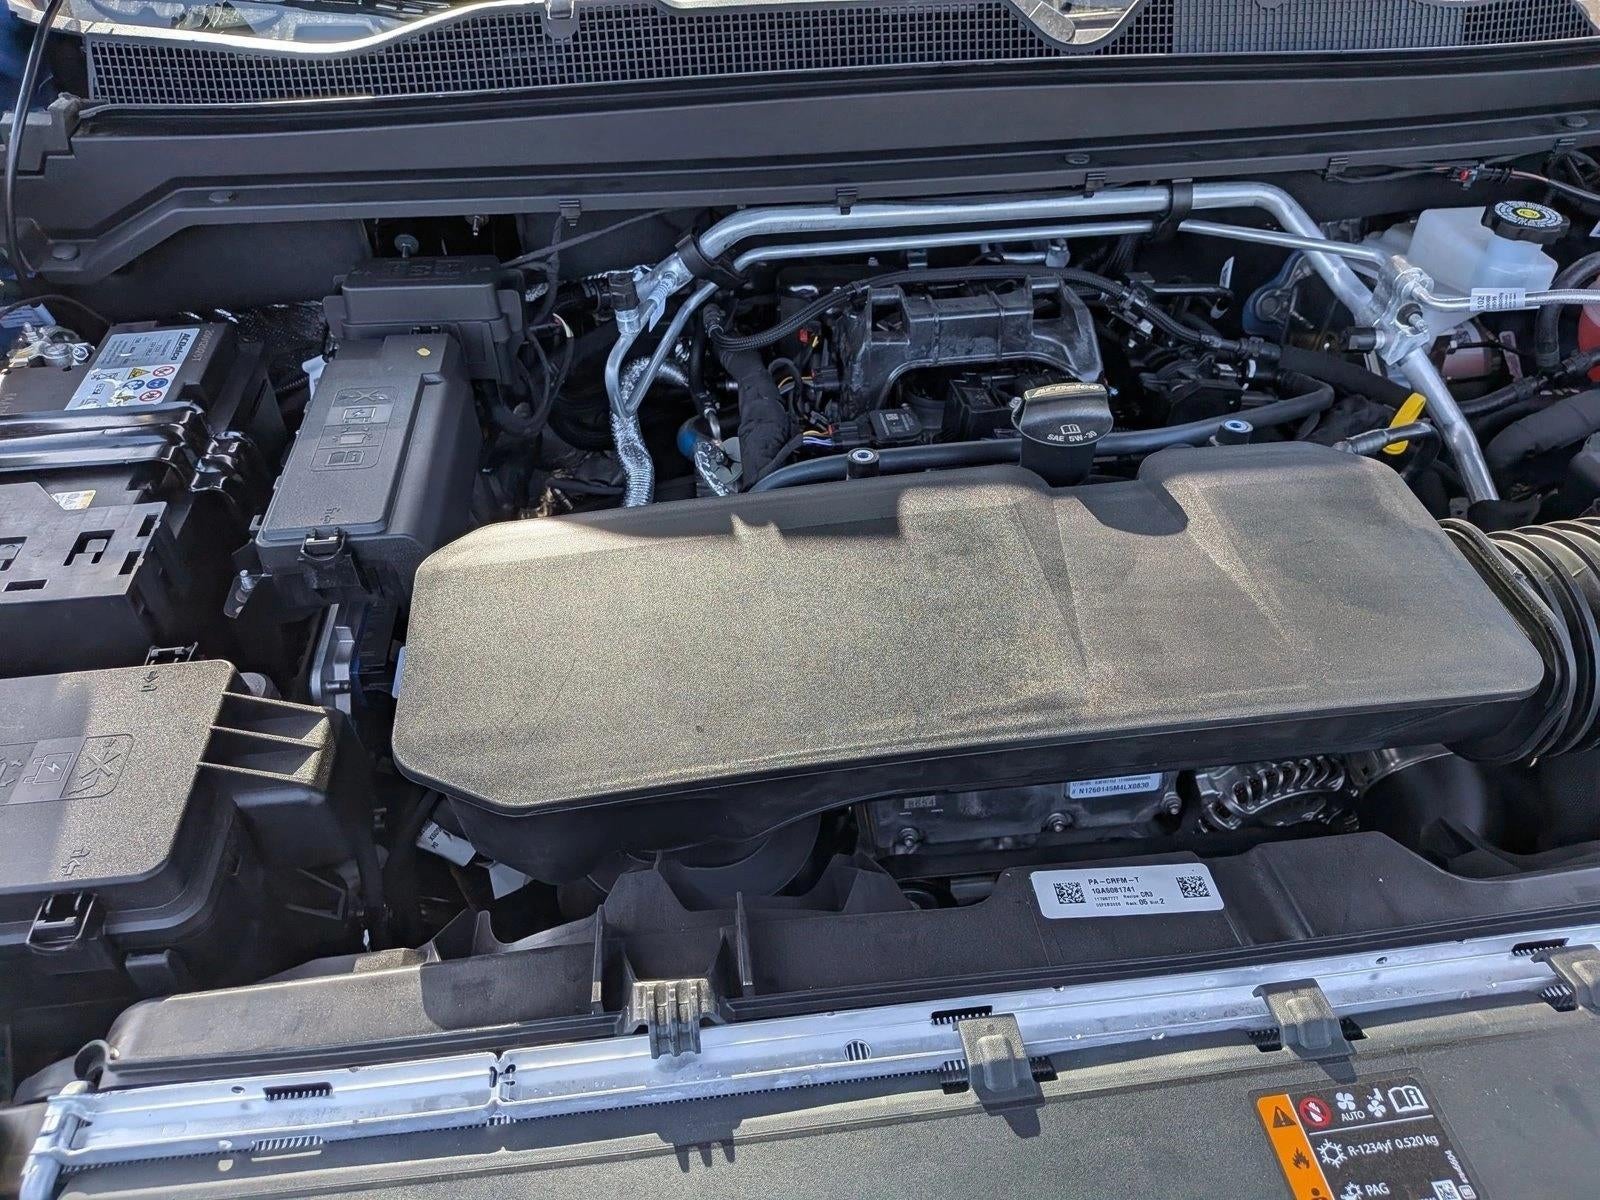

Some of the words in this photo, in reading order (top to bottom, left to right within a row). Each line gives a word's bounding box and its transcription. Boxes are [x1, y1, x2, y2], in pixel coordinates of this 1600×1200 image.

[171, 332, 191, 361] ACDelco
[1047, 433, 1065, 442] SAE
[1069, 430, 1098, 442] 5W-30
[1088, 876, 1140, 885] PA-CRFM-T
[1159, 897, 1165, 905] 2
[1341, 1110, 1366, 1122] AUTO
[1347, 1139, 1393, 1157] R-1234yf
[1394, 1135, 1424, 1150] 0.520
[1422, 1134, 1440, 1147] kg
[1365, 1182, 1391, 1197] PAG
